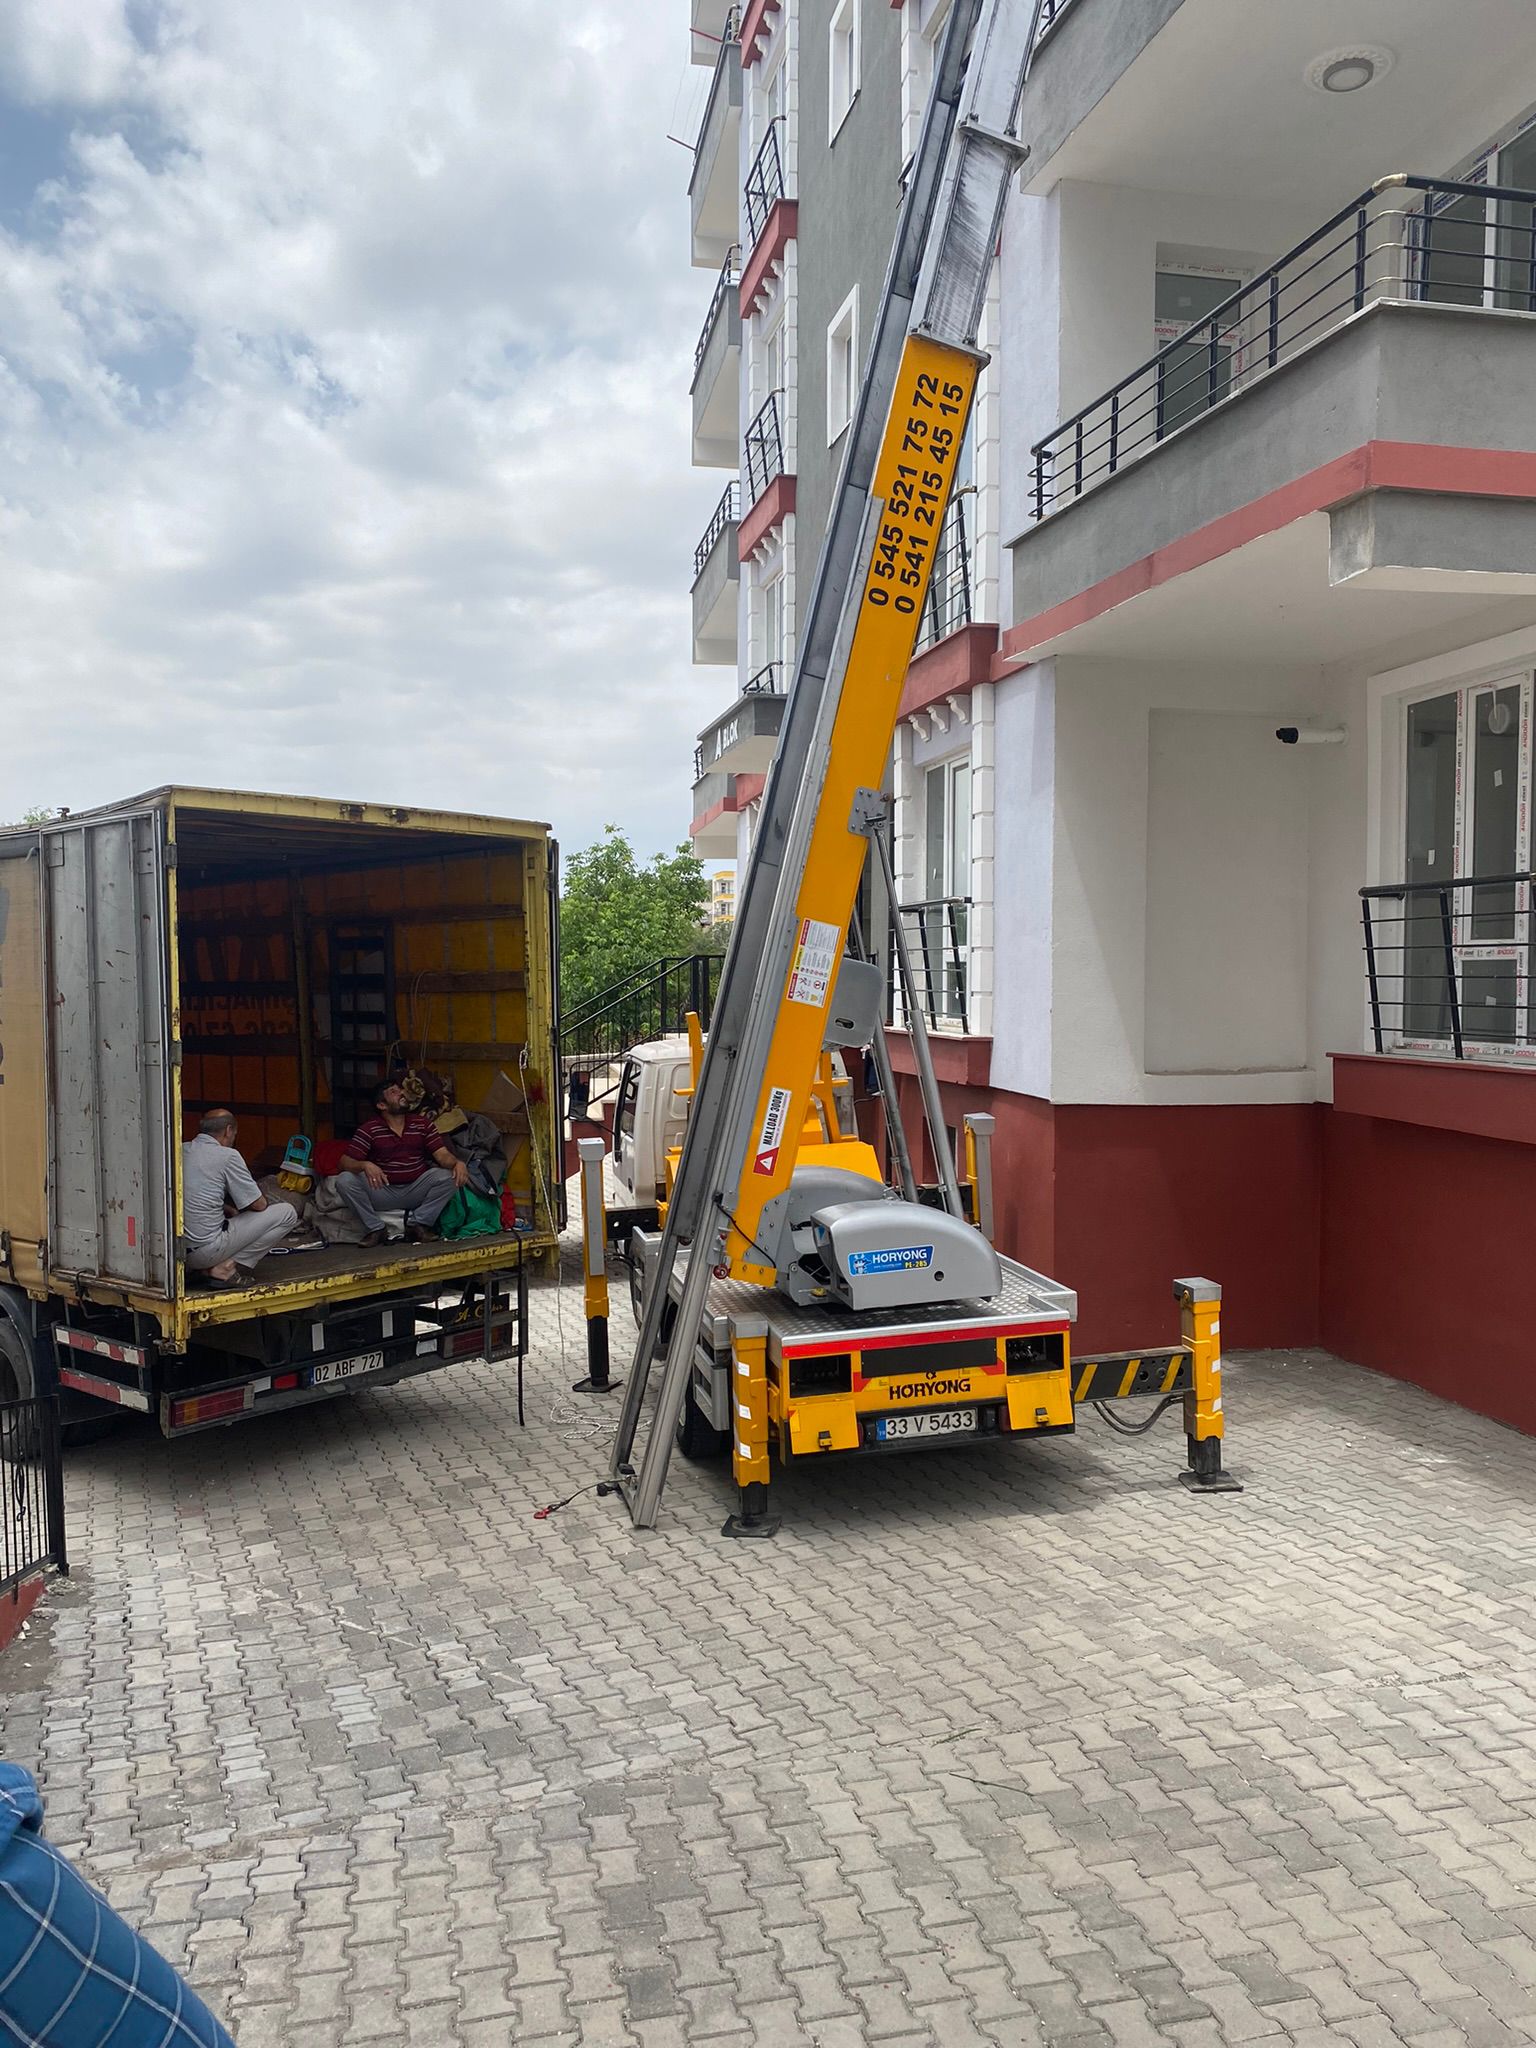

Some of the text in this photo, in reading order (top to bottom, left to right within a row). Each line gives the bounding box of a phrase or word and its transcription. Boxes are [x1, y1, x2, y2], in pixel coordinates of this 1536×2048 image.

[868, 373, 939, 606] 0 545 521 75 72
[894, 382, 964, 614] 0 541 215 45 15
[715, 718, 738, 761] A BLOK
[872, 1248, 928, 1264] HORYONG
[315, 1353, 382, 1382] 02 ABF 727
[889, 1378, 971, 1400] HORYONG
[887, 1411, 973, 1436] 33 V 5433
